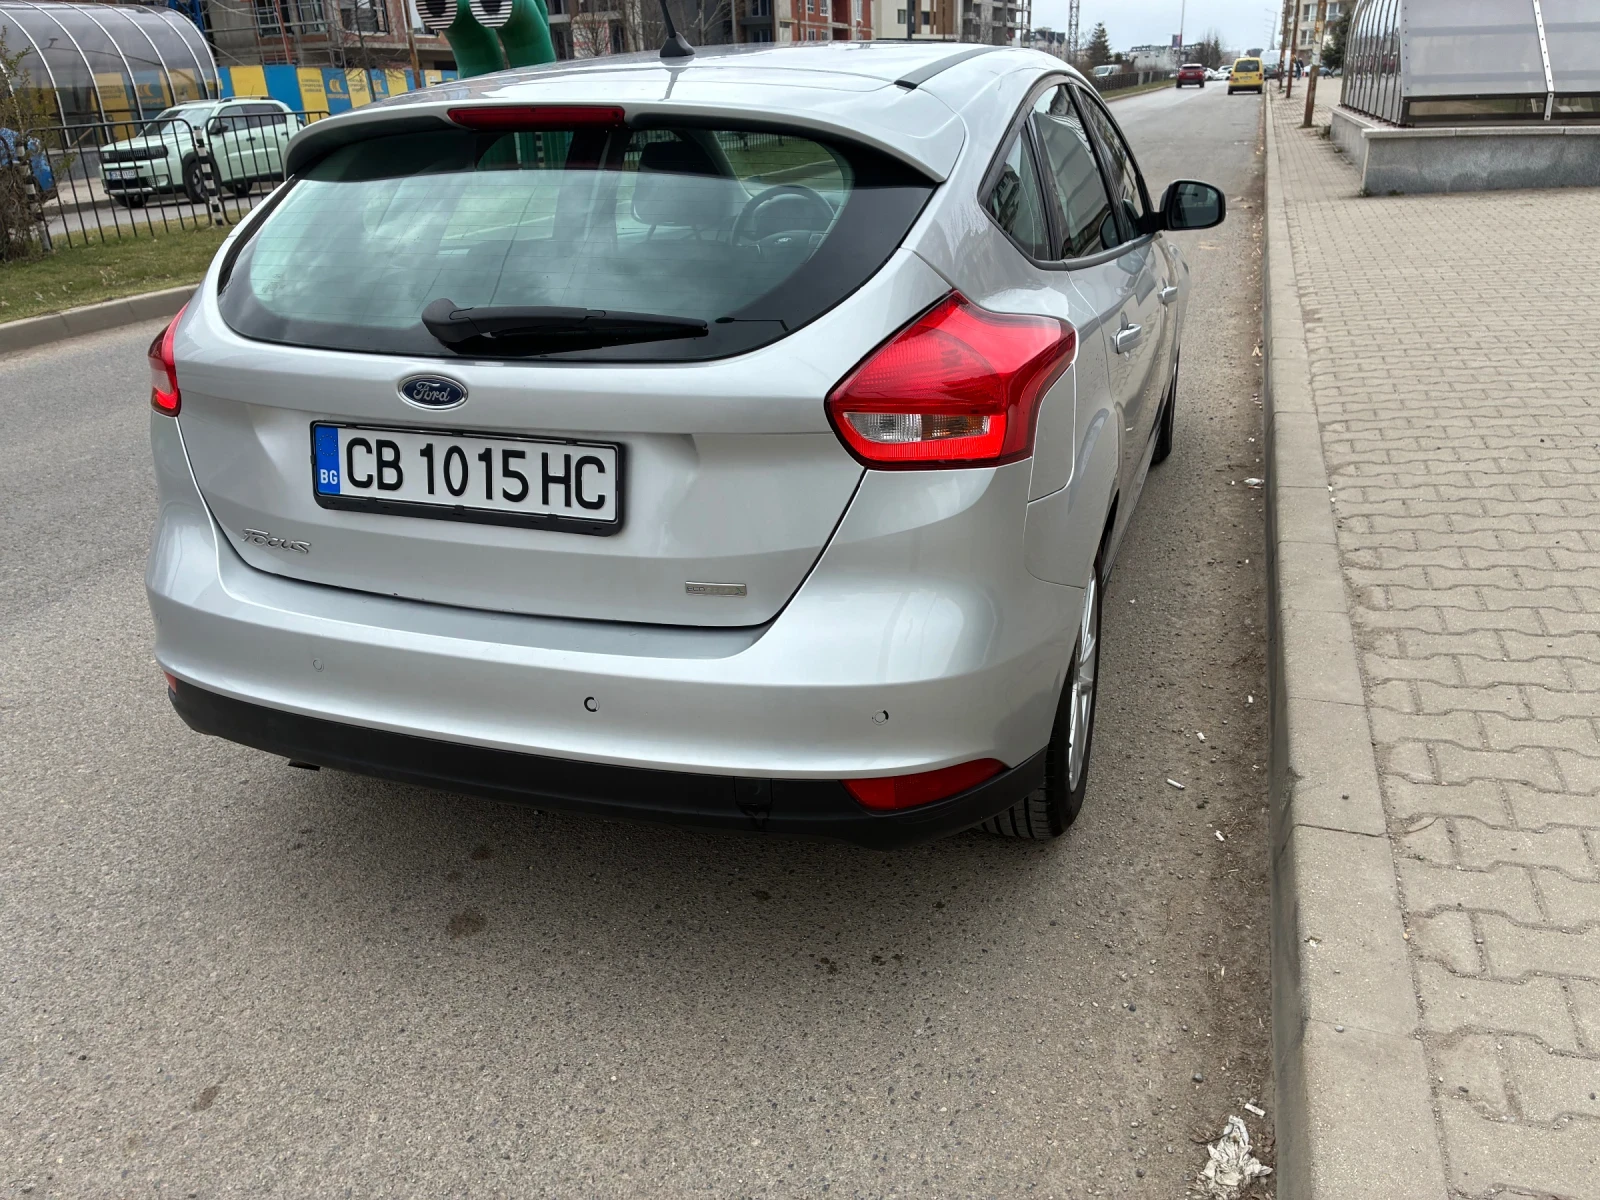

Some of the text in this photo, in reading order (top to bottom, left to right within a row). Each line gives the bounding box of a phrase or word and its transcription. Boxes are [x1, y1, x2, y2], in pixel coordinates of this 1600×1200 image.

[413, 381, 451, 402] Ford
[320, 468, 338, 485] BG
[346, 437, 606, 510] CB 1015 HC
